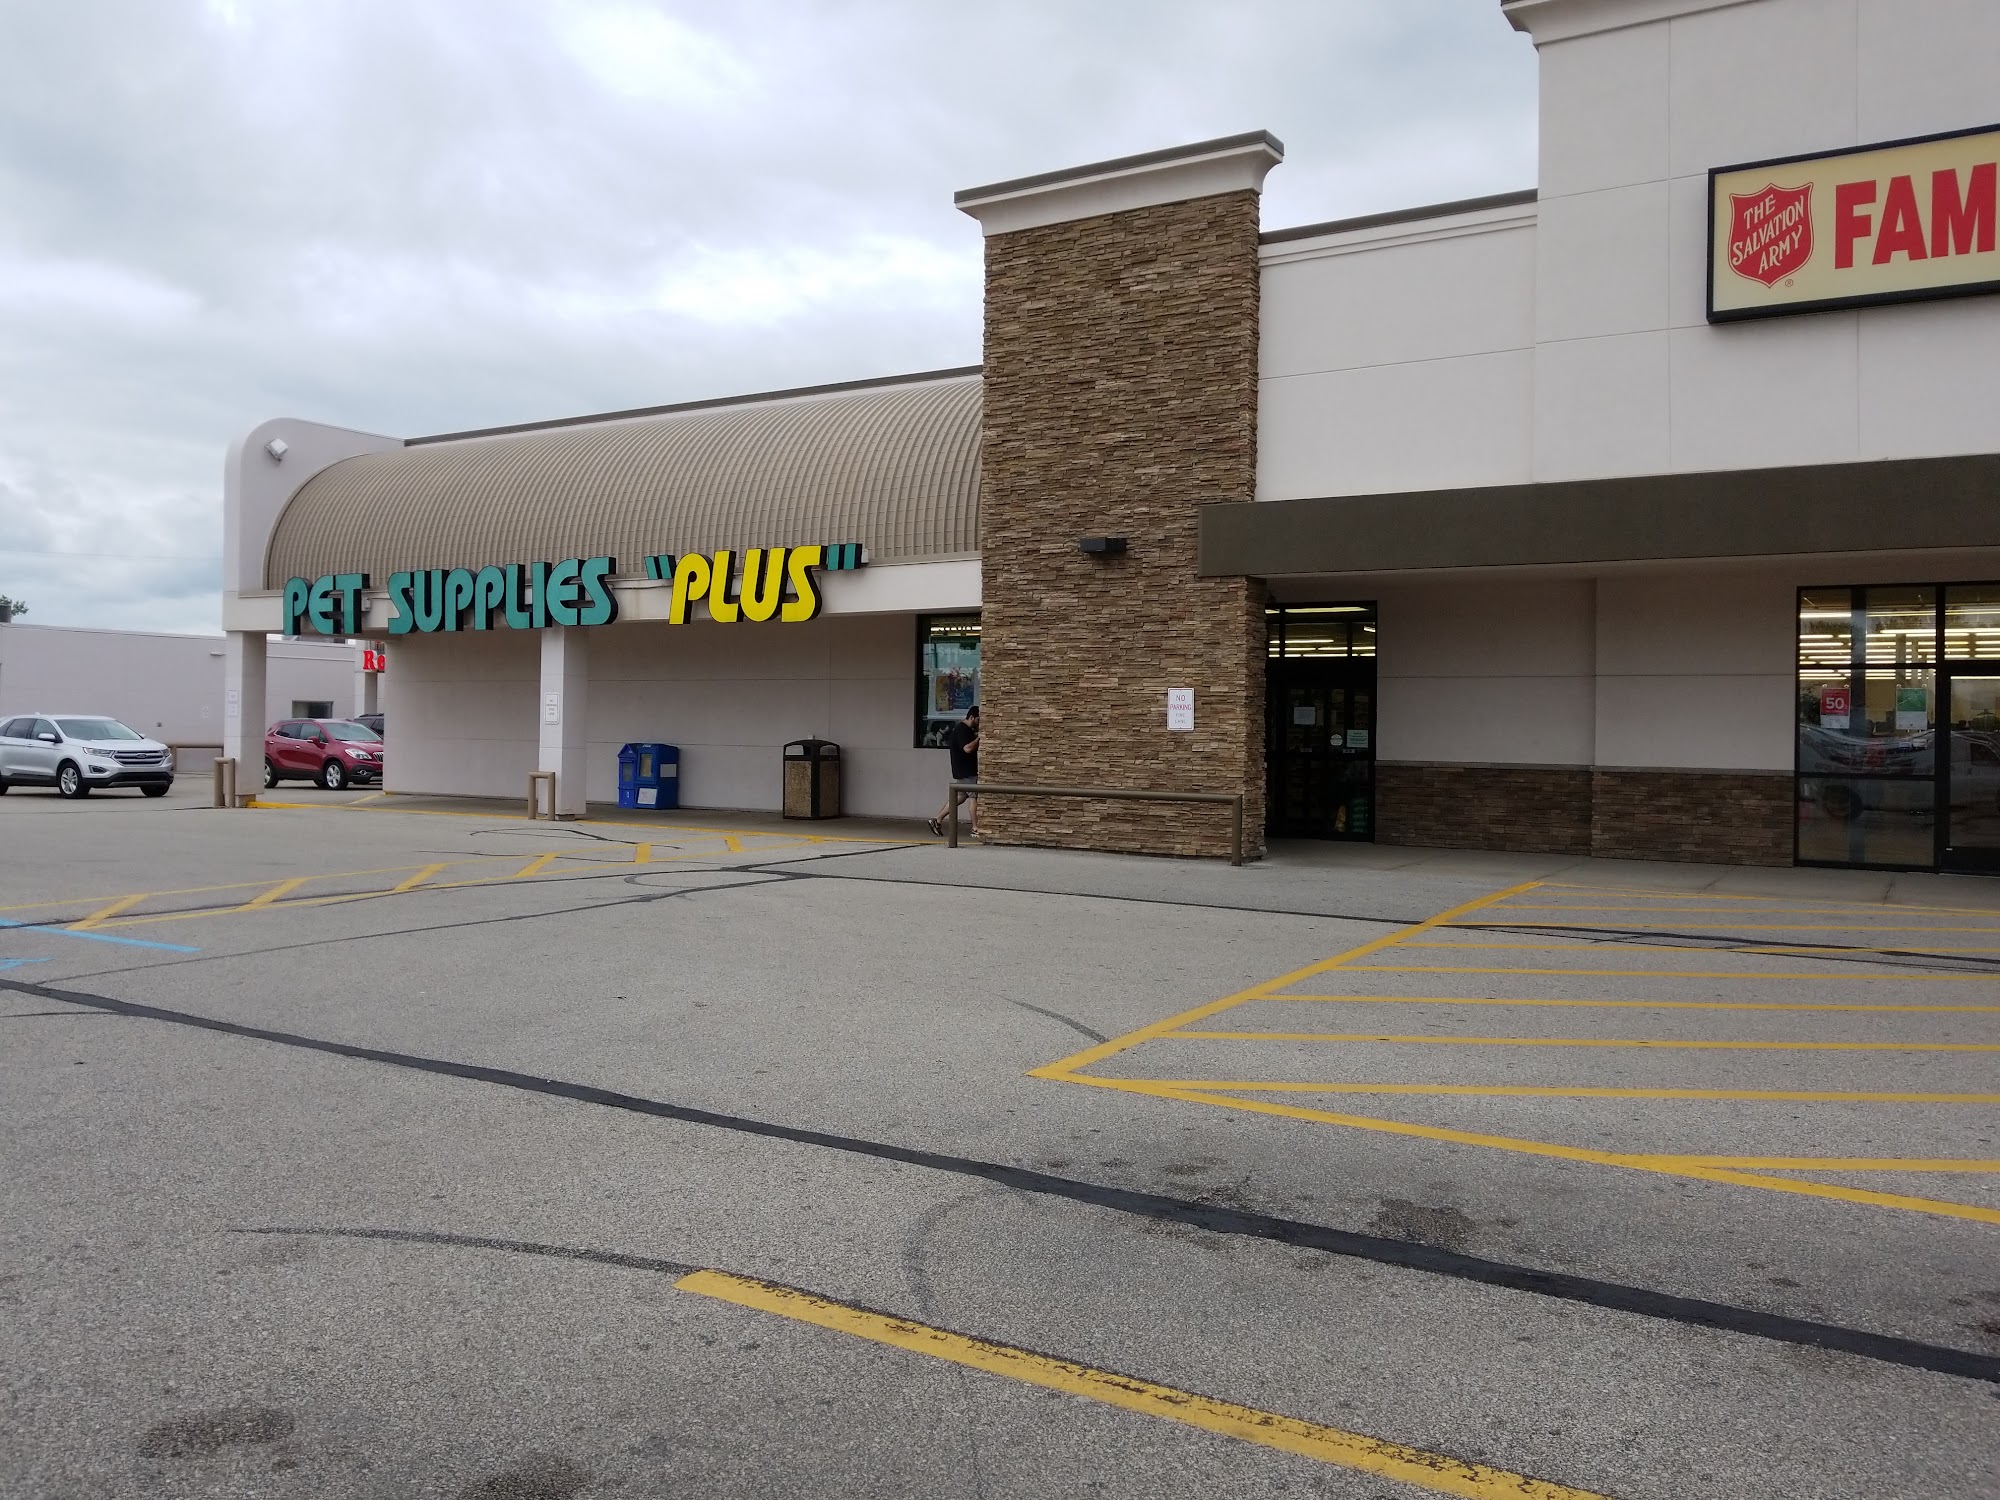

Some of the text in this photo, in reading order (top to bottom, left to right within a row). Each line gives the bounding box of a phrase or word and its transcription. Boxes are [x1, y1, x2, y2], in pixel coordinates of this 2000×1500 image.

[1732, 195, 1804, 266] SALVATION
[1743, 193, 1776, 230] THE
[1835, 162, 1998, 270] FAM
[1758, 225, 1803, 275] ARMY
[283, 573, 367, 635] PET
[388, 557, 617, 634] SUPPLIES
[1826, 697, 1845, 710] 50
